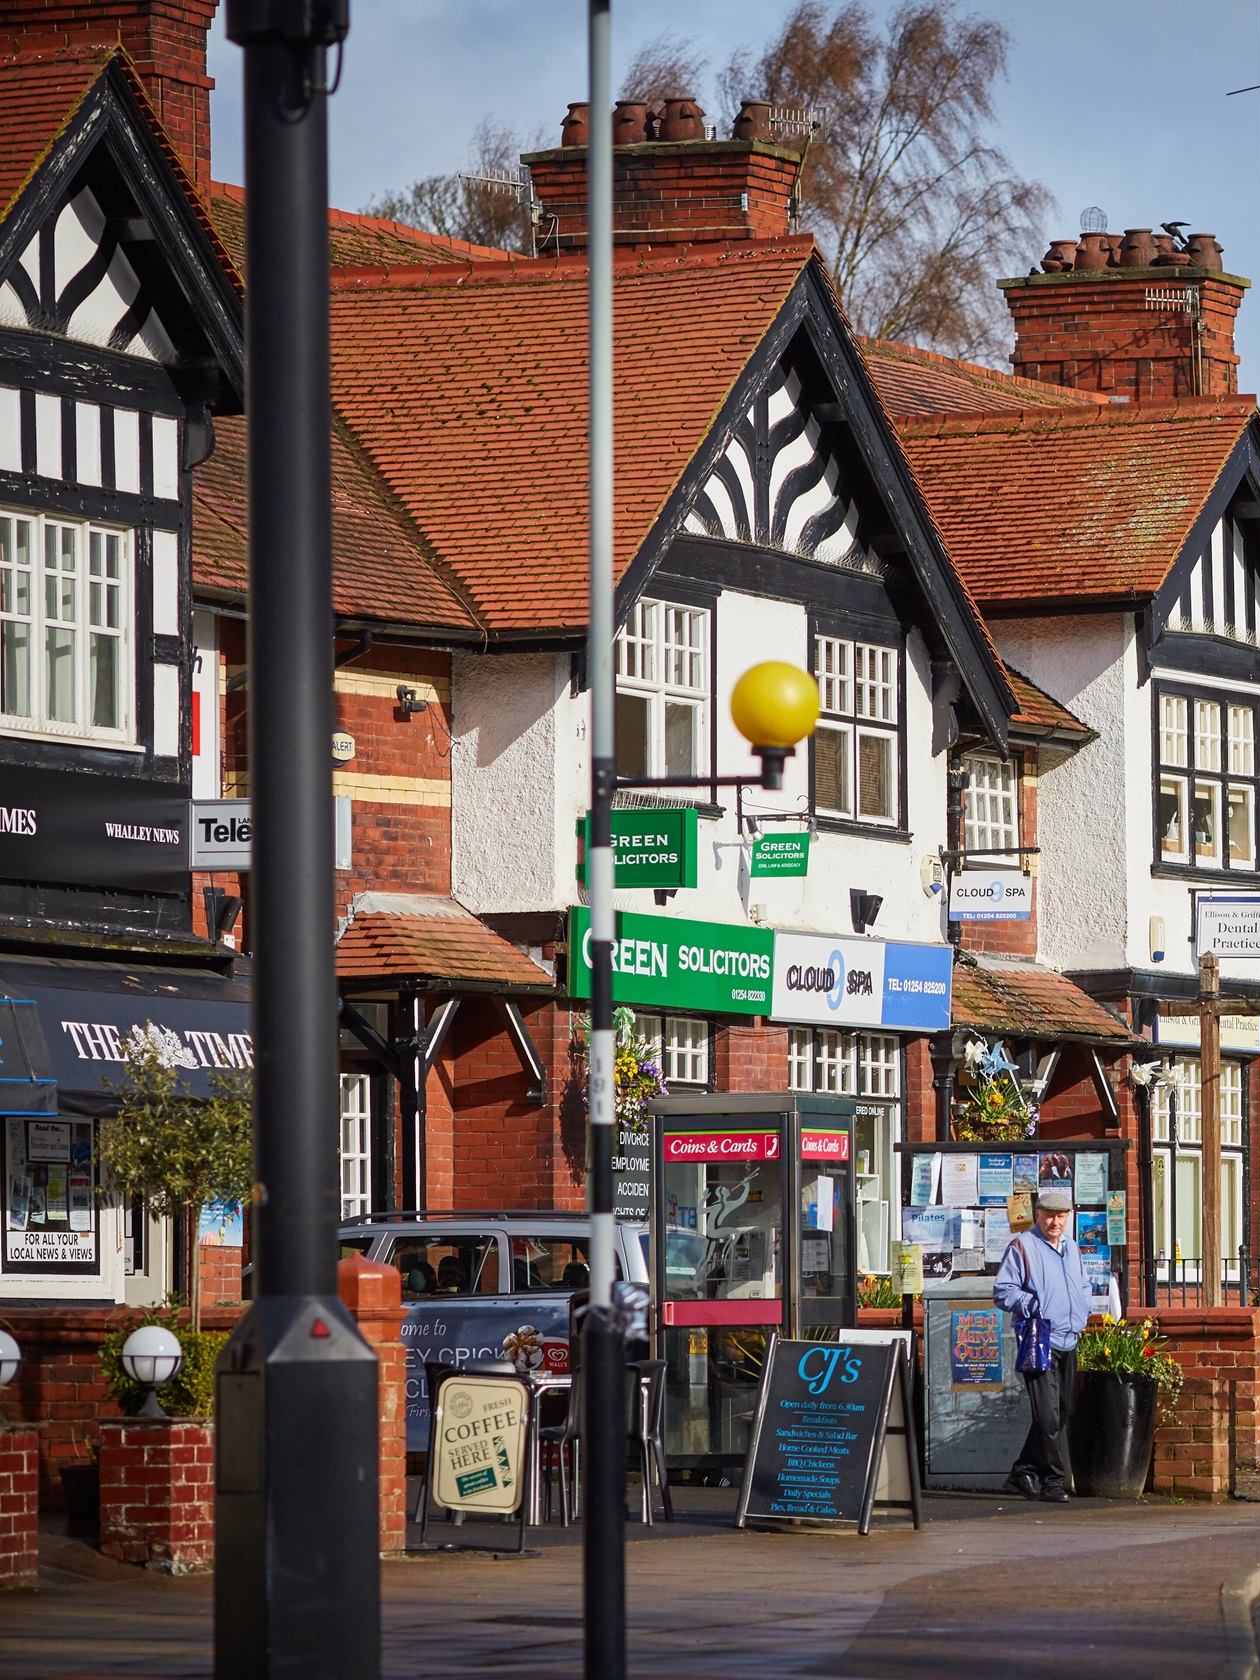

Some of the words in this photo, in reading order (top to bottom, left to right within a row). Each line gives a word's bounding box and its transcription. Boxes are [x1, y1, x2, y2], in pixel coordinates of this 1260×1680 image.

[105, 822, 152, 841] WHALLEY
[153, 828, 180, 844] NEWS
[198, 818, 253, 843] Tele
[760, 842, 801, 851] GREEN
[612, 853, 678, 865] LICITORS
[755, 852, 805, 860] SOLICITORS
[956, 888, 994, 897] CLOUD
[1005, 888, 1026, 897] SPA
[1218, 922, 1258, 934] Dental
[678, 944, 770, 979] SOLICITORS
[786, 964, 835, 993] CLOUD
[846, 969, 873, 996] SPA
[888, 978, 903, 991] TEL:
[903, 979, 922, 993] 01254
[923, 981, 946, 995] 825200
[731, 988, 747, 1001] 01254
[1220, 1017, 1234, 1029] ental
[1235, 1017, 1259, 1032] Practice
[60, 1021, 130, 1063] THE
[35, 1124, 50, 1132] Read
[619, 1131, 649, 1147] DIVORCE
[670, 1139, 706, 1154] Coins
[707, 1140, 719, 1154] &
[720, 1138, 758, 1154] Cards
[802, 1137, 818, 1152] Coins
[817, 1139, 823, 1152] &
[822, 1138, 839, 1153] Cards
[611, 1157, 649, 1171] EMPLOYME
[911, 1213, 945, 1223] Pilates
[25, 1233, 39, 1246] FOR
[42, 1233, 55, 1246] ALL
[57, 1233, 79, 1246] YOUR
[10, 1247, 34, 1259] LOCAL
[36, 1247, 59, 1260] NEWS
[61, 1248, 67, 1260] &
[69, 1248, 93, 1260] VIEWS
[957, 1313, 998, 1327] Mad
[401, 1323, 430, 1337] ome
[434, 1319, 447, 1336] to
[956, 1327, 998, 1344] March
[405, 1348, 432, 1367] EY
[954, 1343, 999, 1361] Quiz
[797, 1347, 863, 1395] CJ's
[405, 1378, 430, 1398] CL
[407, 1403, 431, 1418] Firs
[482, 1397, 512, 1413] FRESH
[780, 1400, 800, 1409] Open
[801, 1401, 818, 1410] daily
[819, 1402, 837, 1410] from
[444, 1410, 518, 1443] COFFEE
[802, 1415, 838, 1424] Breakfasts
[776, 1428, 816, 1438] Sandwiches
[825, 1431, 845, 1439] Salad
[845, 1432, 858, 1440] Bar
[448, 1439, 488, 1458] SERVED
[778, 1443, 800, 1451] Home
[801, 1444, 828, 1453] Cooked
[828, 1446, 850, 1454] Meats
[451, 1448, 491, 1470] HERE
[787, 1459, 803, 1468] BBQ
[803, 1460, 835, 1468] Chickens
[777, 1473, 817, 1482] Homemade
[818, 1475, 841, 1485] Soups
[783, 1489, 802, 1498] Daily
[803, 1490, 831, 1499] Specials
[787, 1504, 808, 1512] Bread
[808, 1505, 815, 1513] &
[816, 1506, 837, 1514] Cakes
